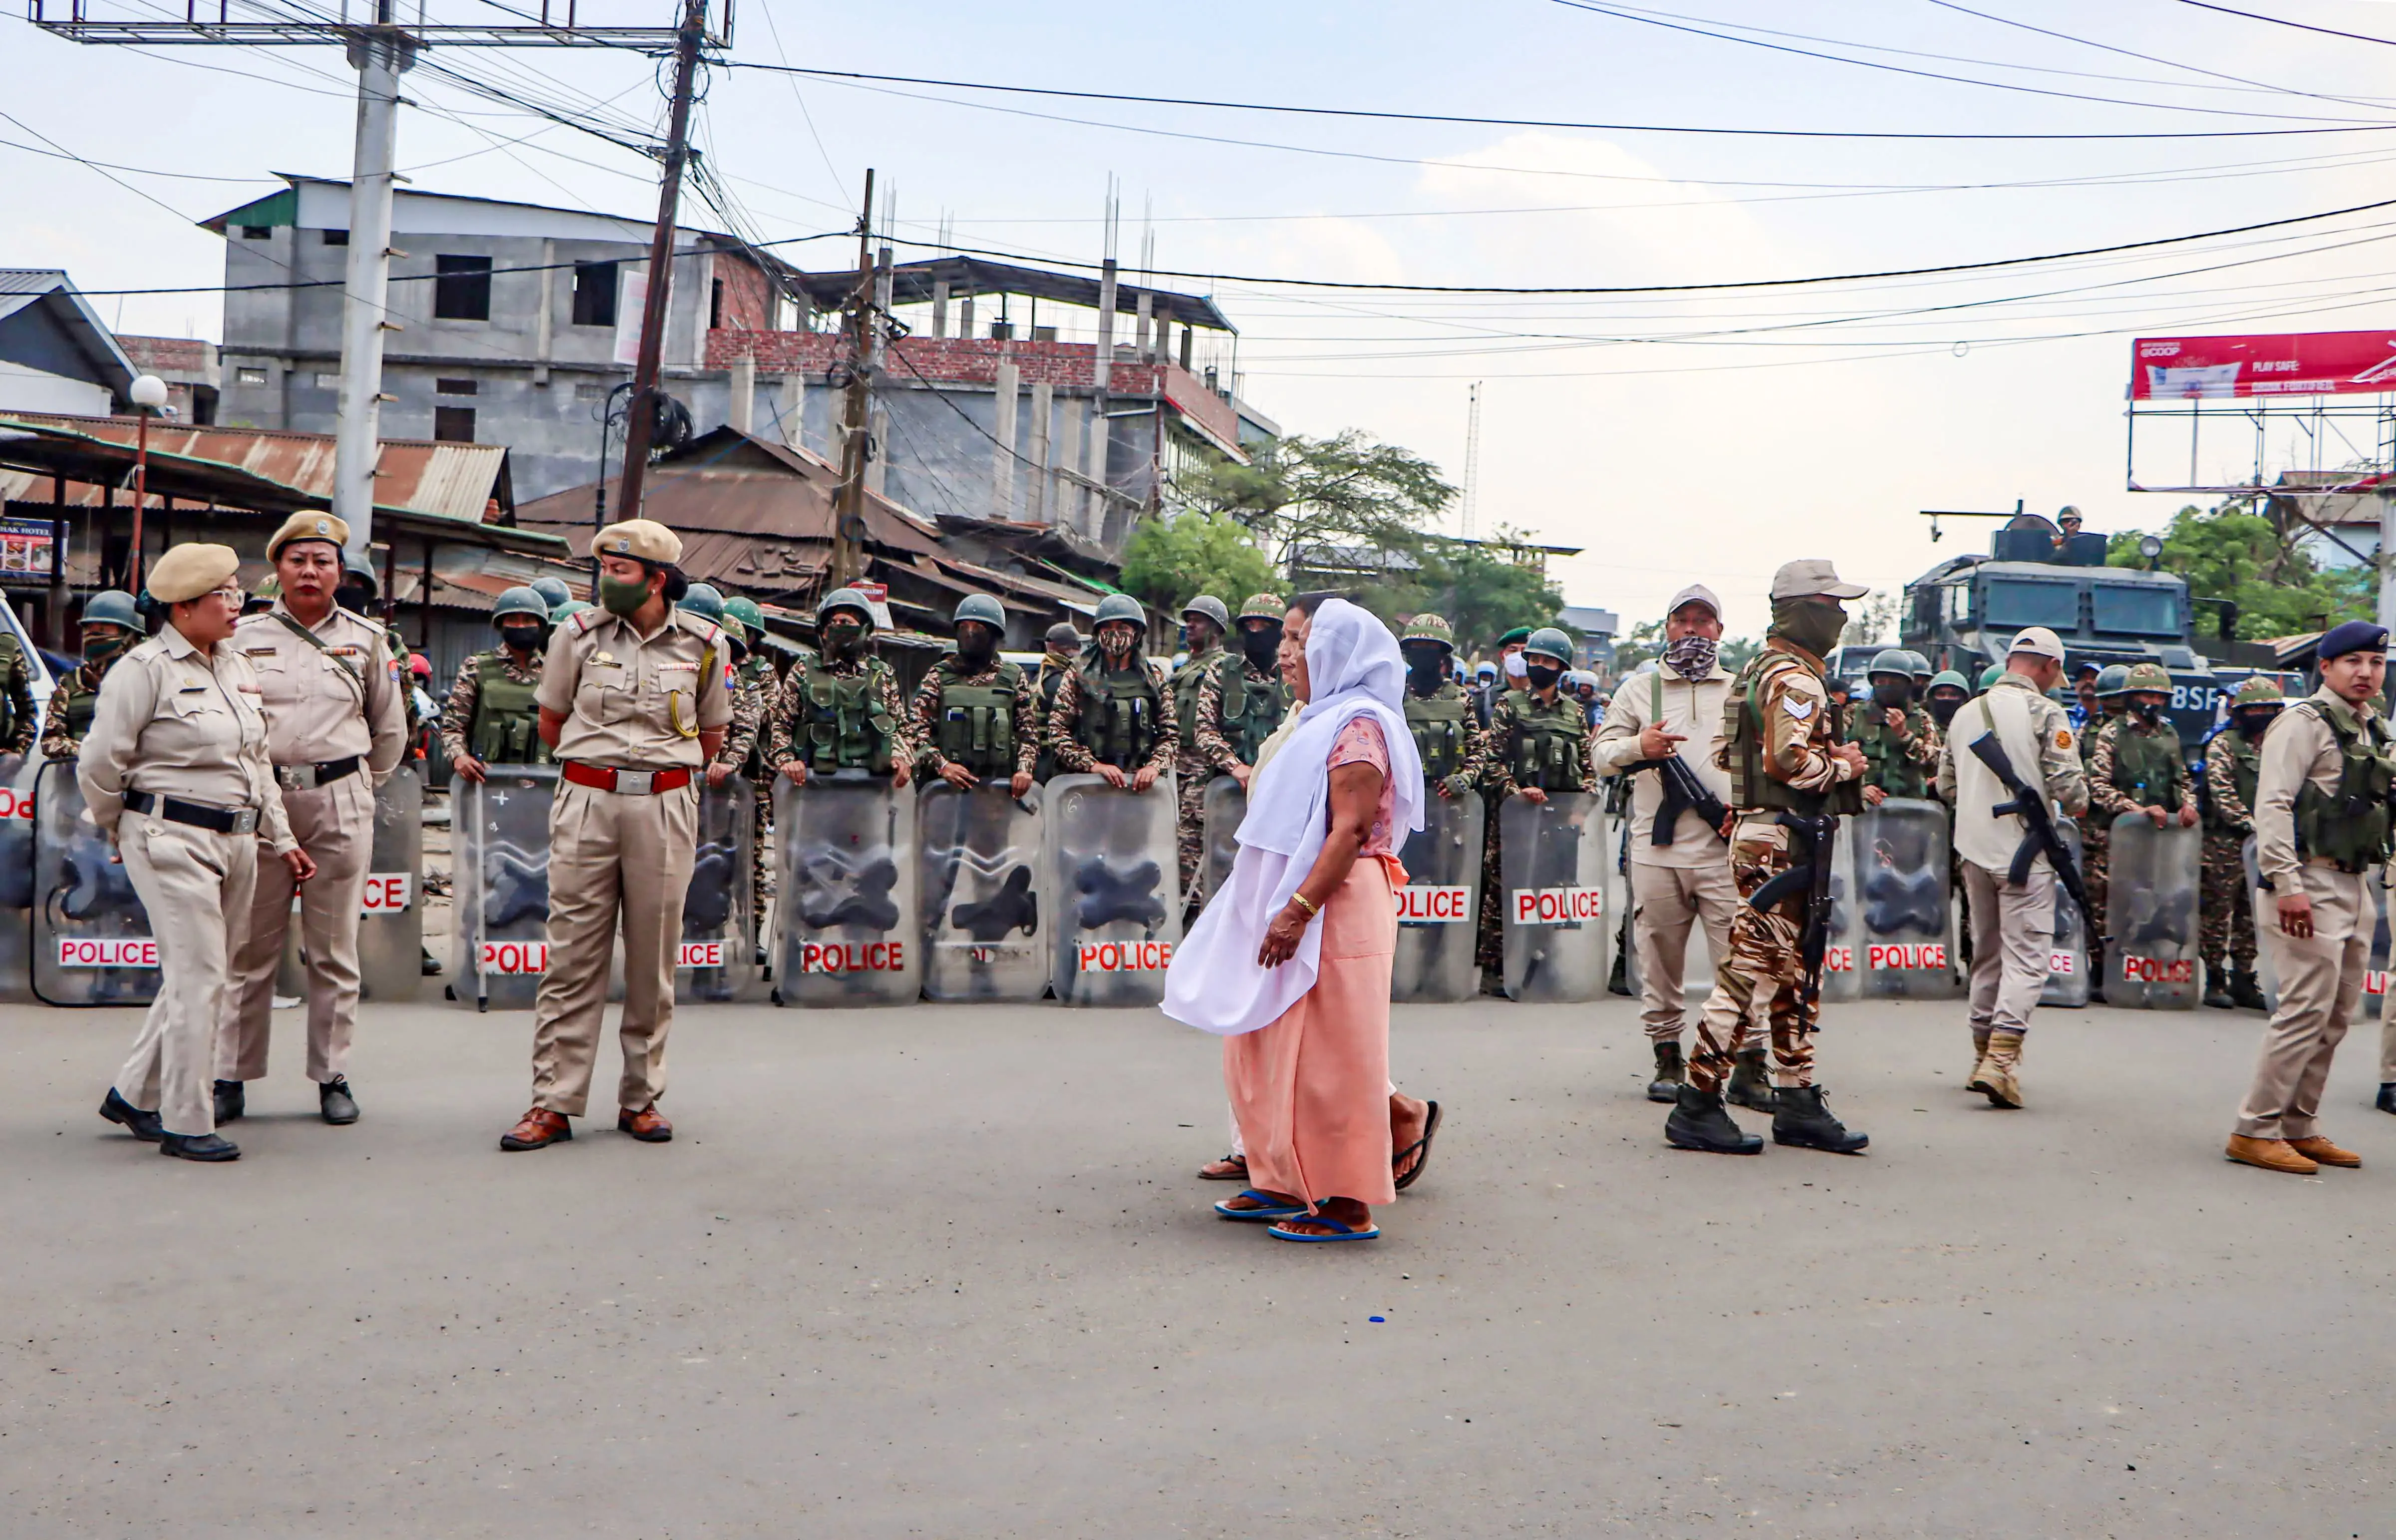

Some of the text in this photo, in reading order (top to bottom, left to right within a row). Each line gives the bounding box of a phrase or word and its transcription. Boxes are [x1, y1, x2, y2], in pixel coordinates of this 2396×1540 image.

[22, 528, 51, 536] HOTEL
[2171, 685, 2219, 710] BSF
[1519, 892, 1600, 921] POLICE
[62, 942, 157, 963] POLICE
[677, 944, 720, 964] ICE
[803, 942, 904, 972] POLICE
[1080, 943, 1172, 970] POLICE
[1869, 946, 1946, 969] POLICE
